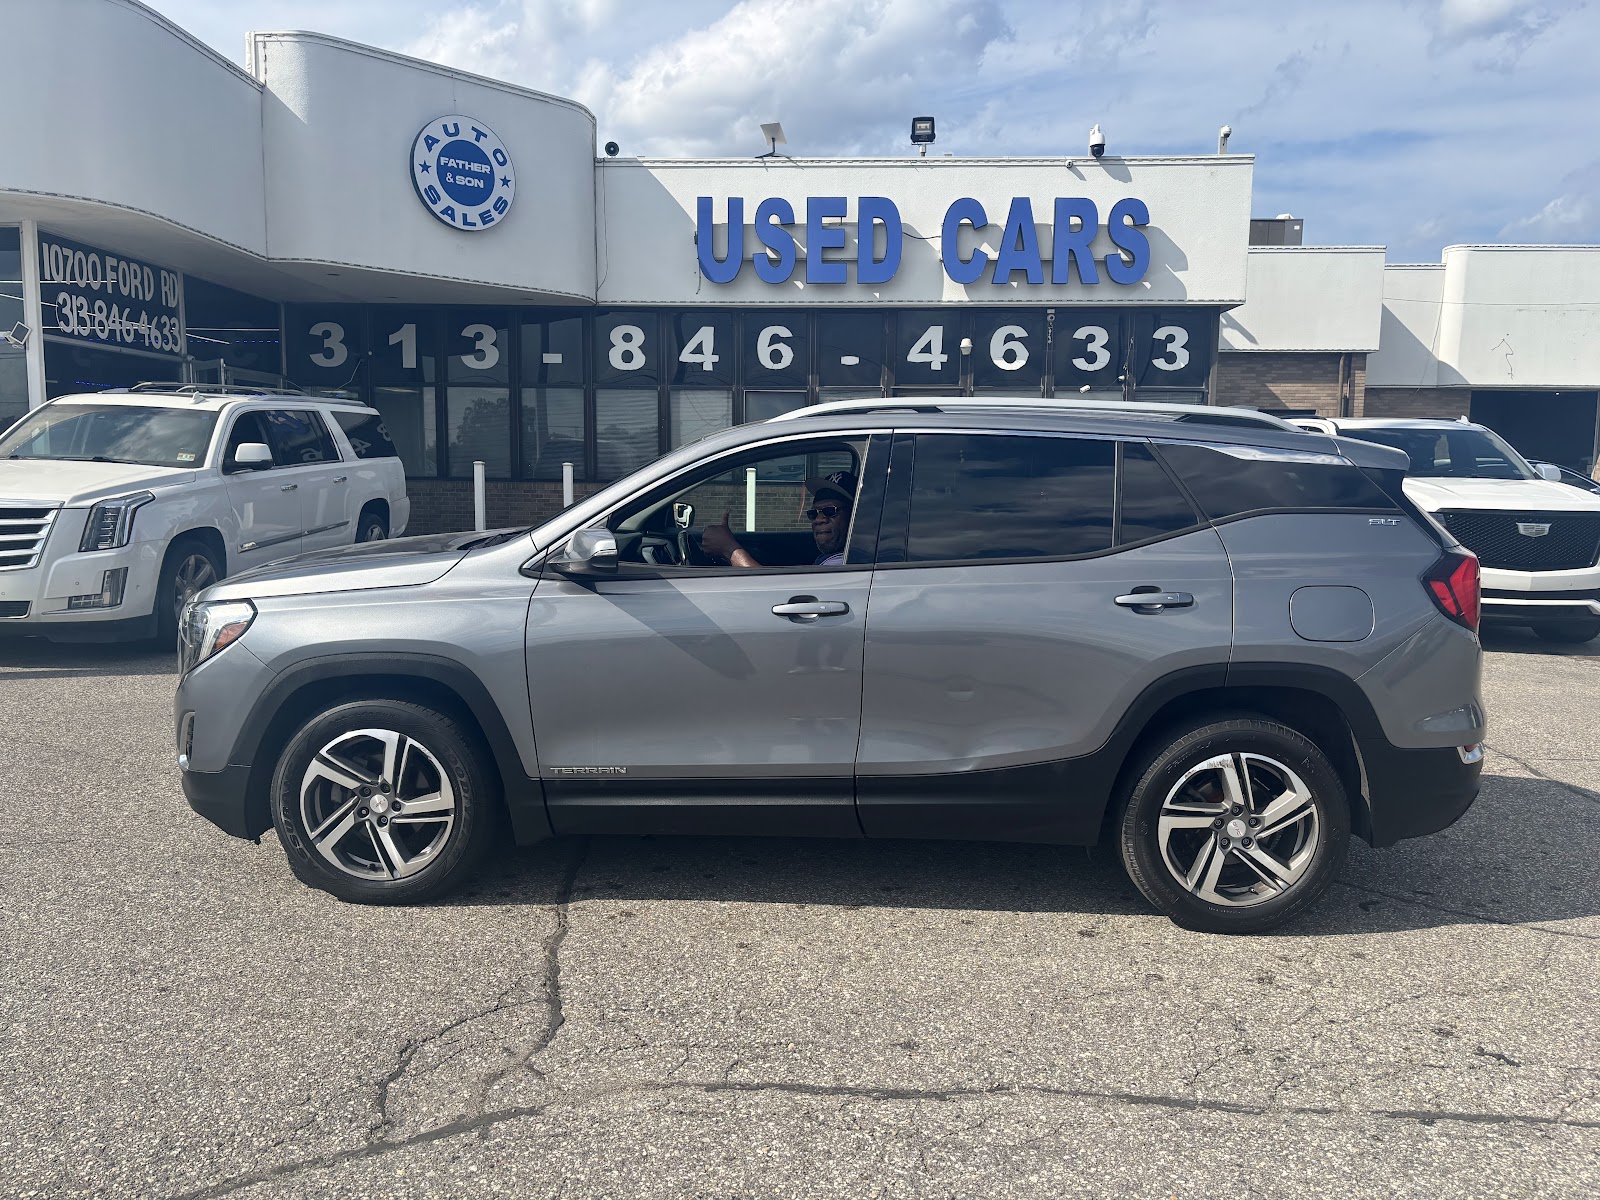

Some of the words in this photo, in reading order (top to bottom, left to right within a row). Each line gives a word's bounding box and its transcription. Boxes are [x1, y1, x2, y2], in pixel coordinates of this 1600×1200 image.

[423, 122, 508, 167] AUTO
[440, 156, 491, 174] FATHER
[445, 172, 455, 184] &
[455, 176, 484, 189] SON
[423, 184, 509, 227] SALES
[696, 197, 902, 284] USED
[941, 197, 1150, 284] CARS
[42, 242, 101, 291] 10700
[105, 256, 155, 302] FORD
[160, 270, 179, 305] RD
[1368, 518, 1401, 526] SLT
[549, 766, 627, 774] TERRAIN
